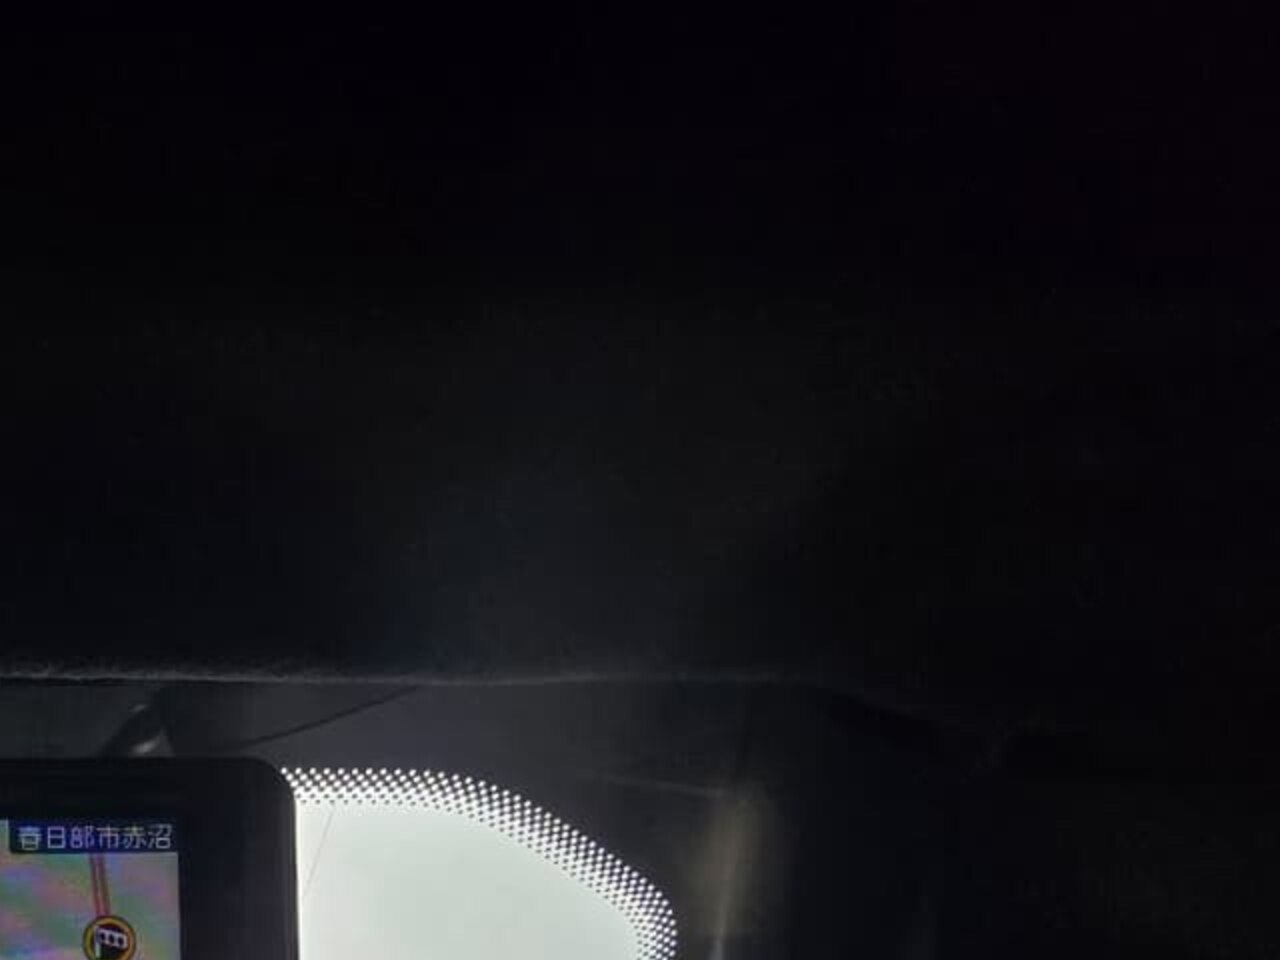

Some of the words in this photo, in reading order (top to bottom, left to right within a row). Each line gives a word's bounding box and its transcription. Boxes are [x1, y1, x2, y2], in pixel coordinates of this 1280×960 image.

[18, 824, 173, 850] 春日部市赤沼
